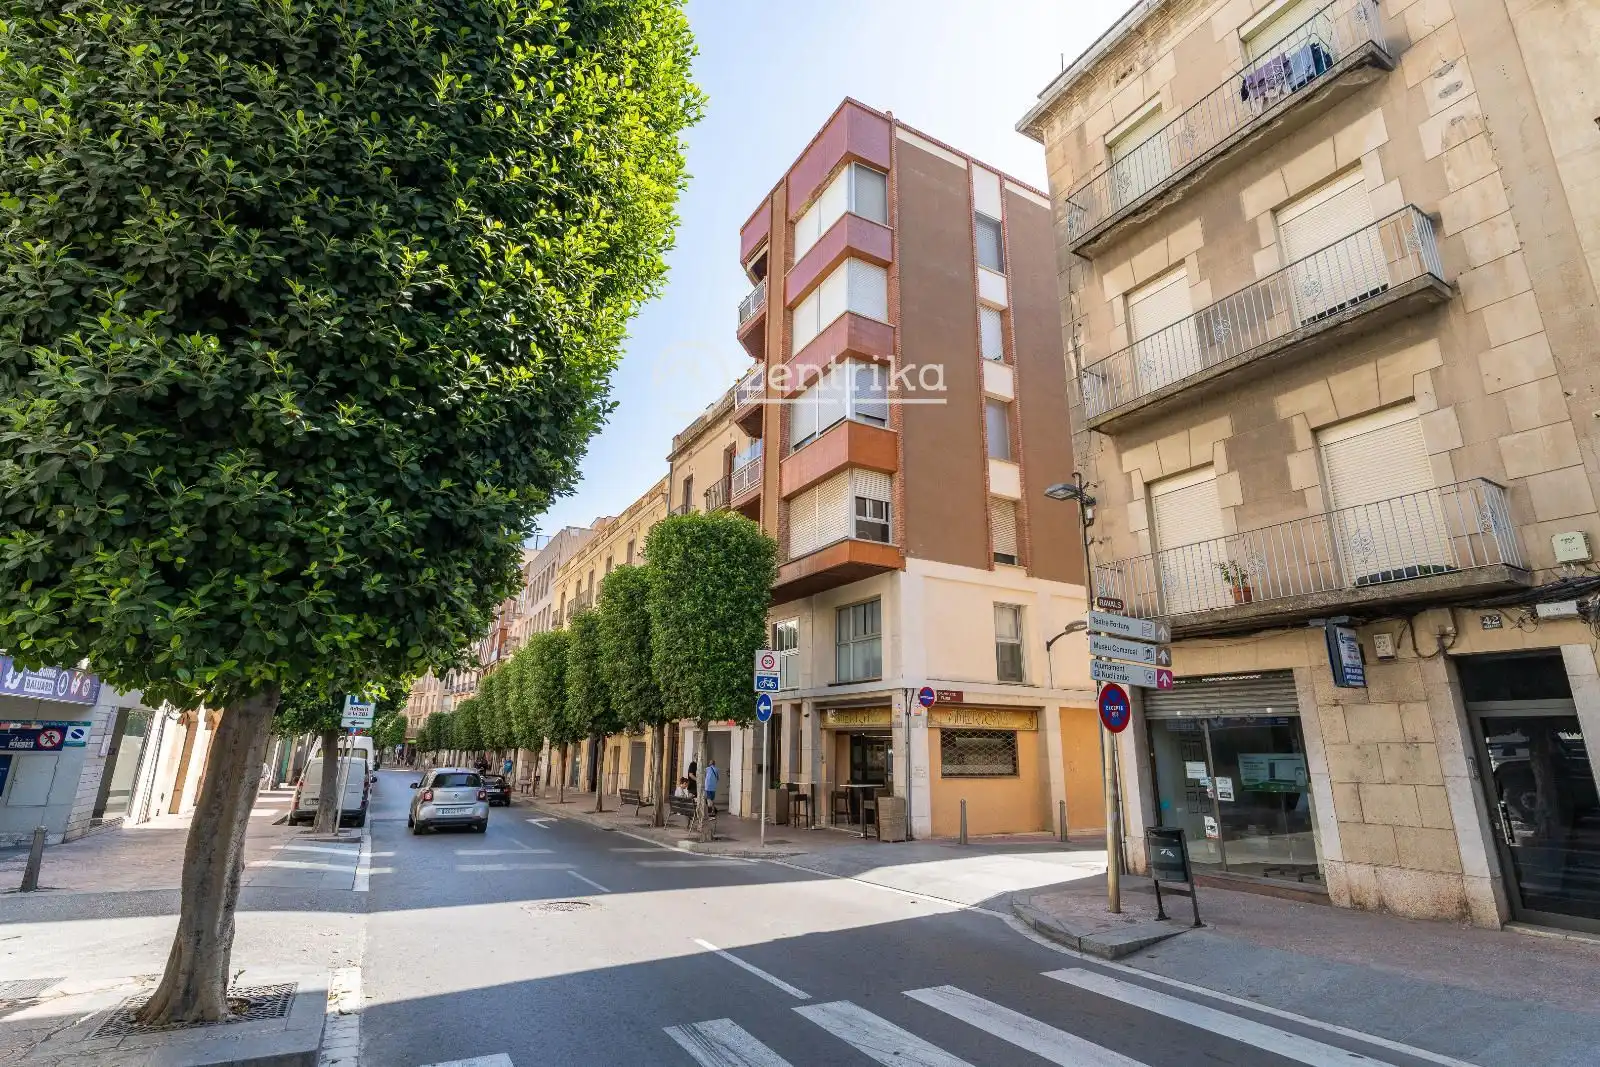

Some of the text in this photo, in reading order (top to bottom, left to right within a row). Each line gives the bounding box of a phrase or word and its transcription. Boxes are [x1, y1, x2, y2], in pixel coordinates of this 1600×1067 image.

[1099, 599, 1122, 609] RAVALS
[1092, 616, 1130, 632] Teatre Fortuny
[1483, 615, 1500, 625] 42
[1093, 641, 1111, 651] Museu
[1094, 661, 1125, 672] Ajuntament
